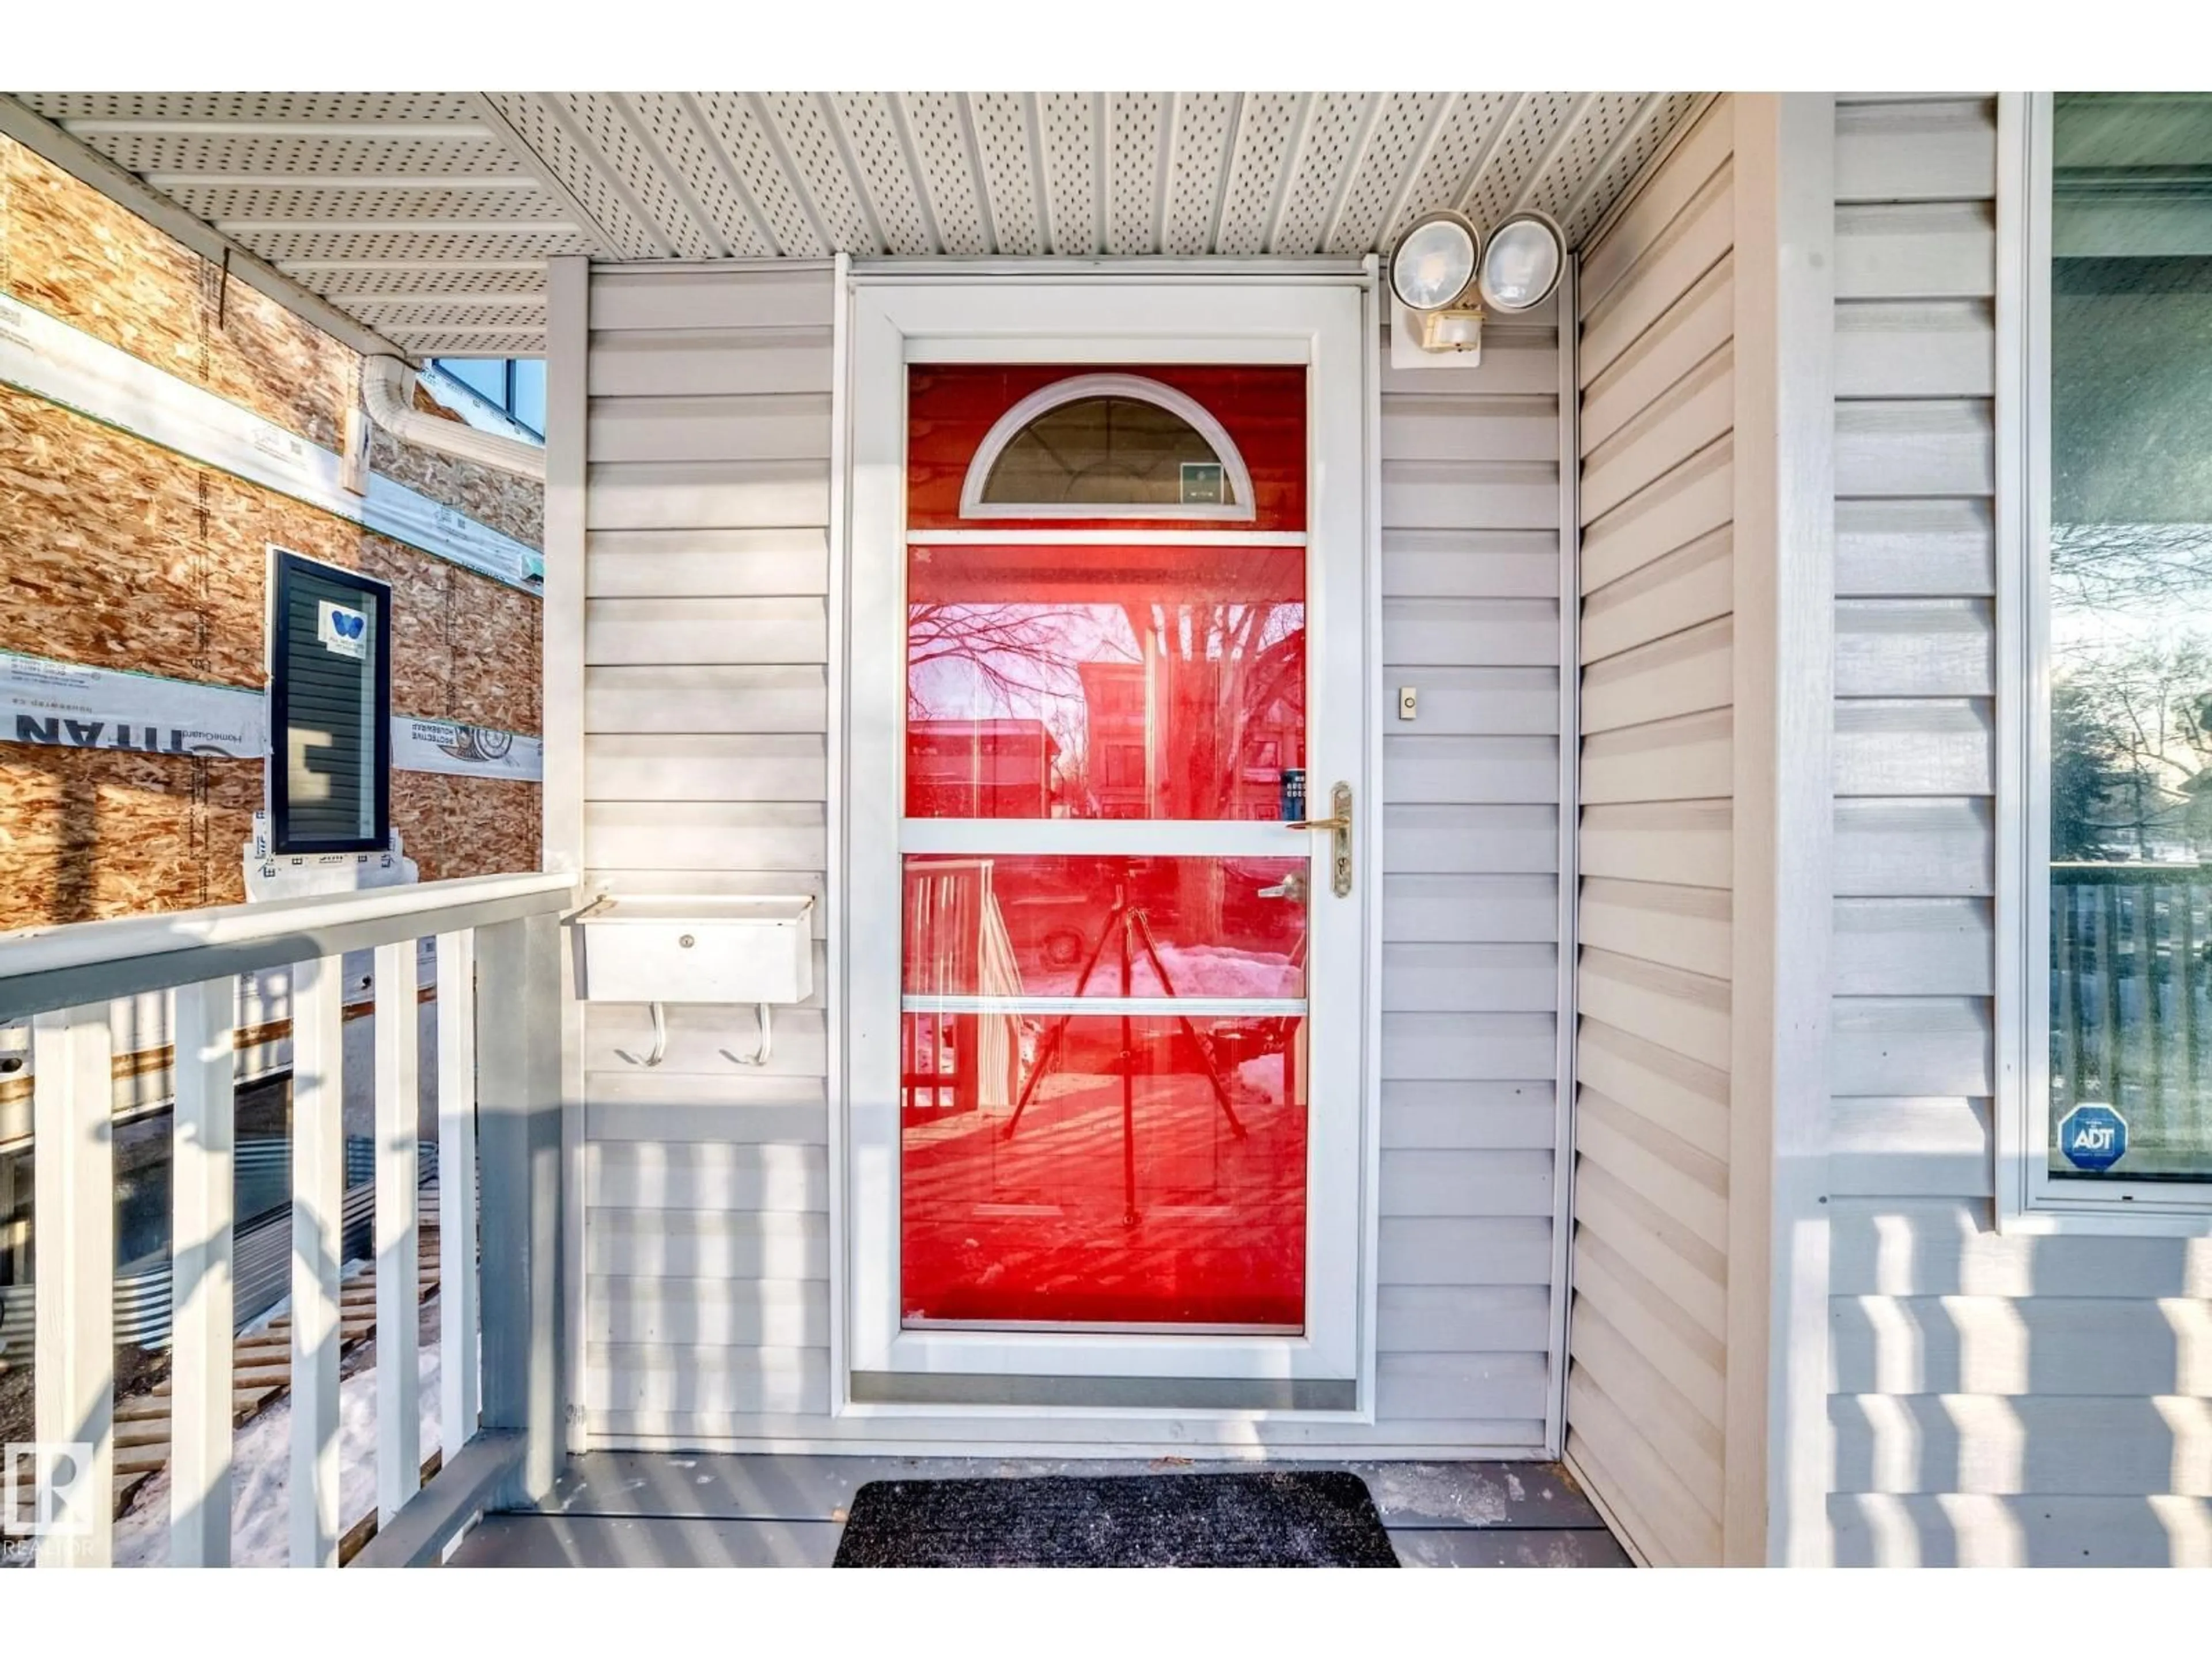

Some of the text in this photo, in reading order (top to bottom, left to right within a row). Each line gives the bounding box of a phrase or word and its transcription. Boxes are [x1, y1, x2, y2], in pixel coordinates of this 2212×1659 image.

[16, 714, 193, 754] TITAN
[183, 729, 242, 743] HomeGuard
[2073, 1128, 2115, 1149] ADT
